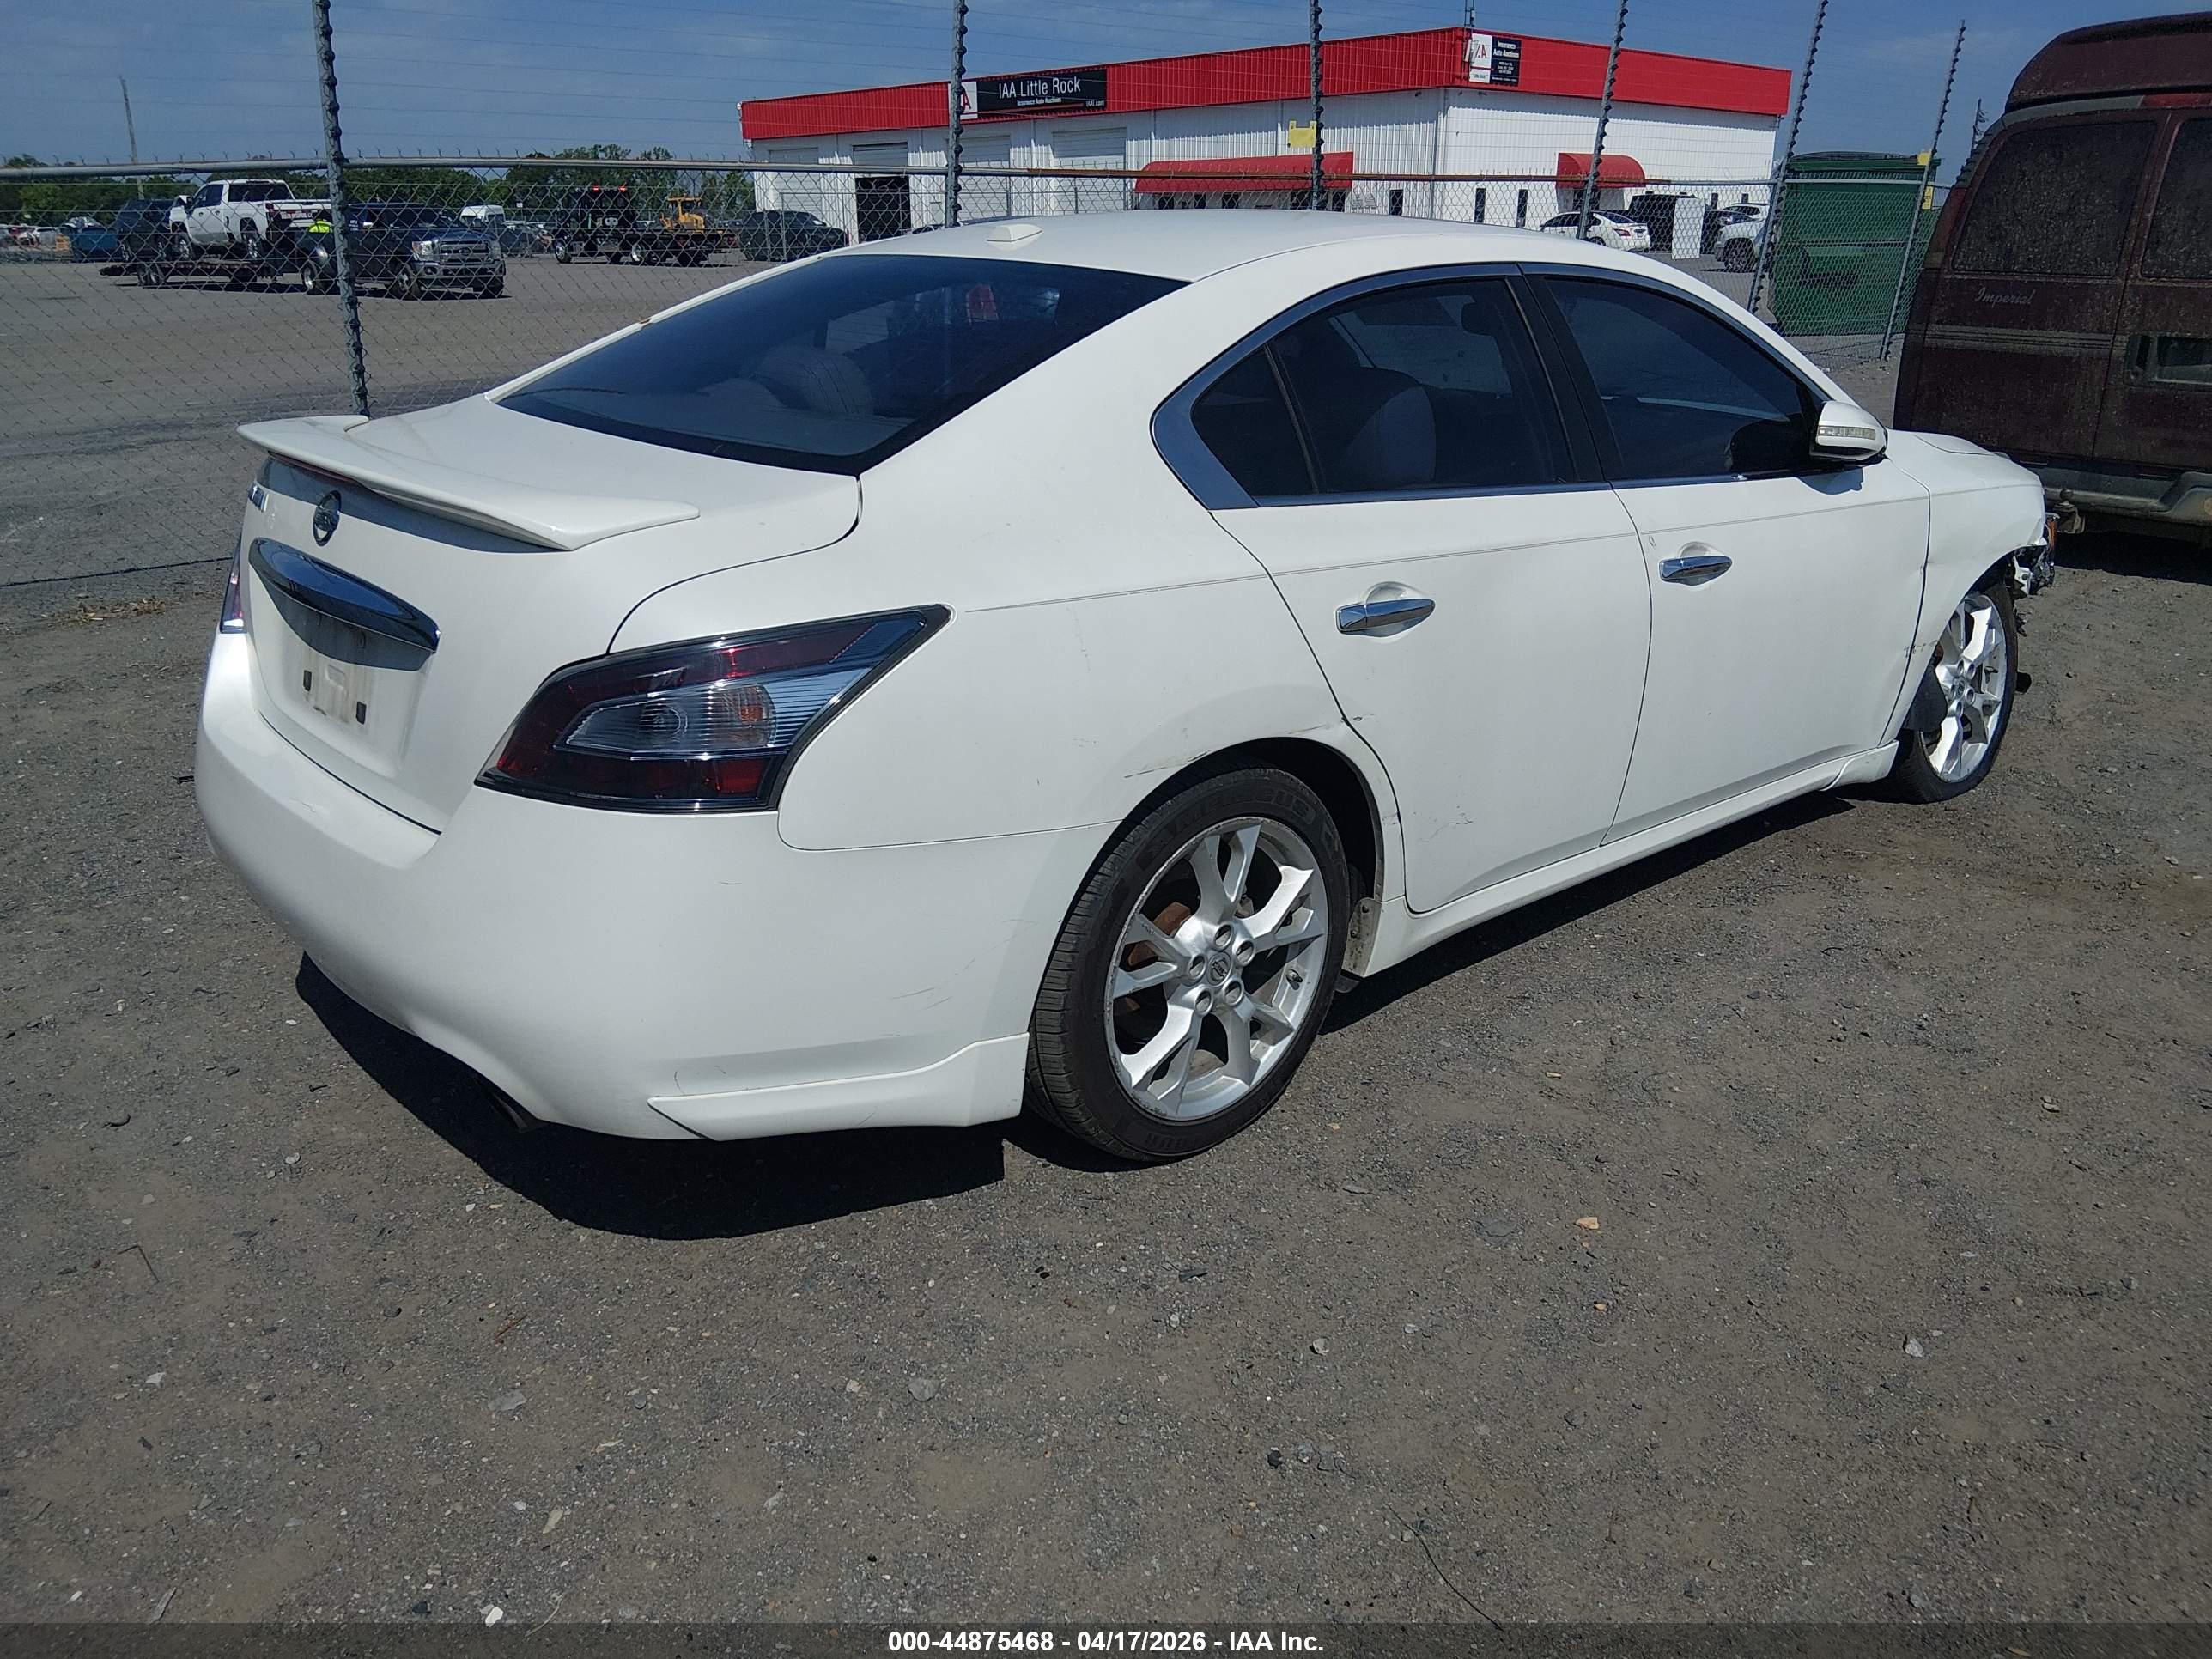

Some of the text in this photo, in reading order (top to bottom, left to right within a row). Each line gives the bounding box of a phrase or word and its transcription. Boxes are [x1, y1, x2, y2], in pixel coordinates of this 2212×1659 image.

[999, 76, 1081, 100] IAA Little Rock
[1974, 286, 2036, 308] Imperial
